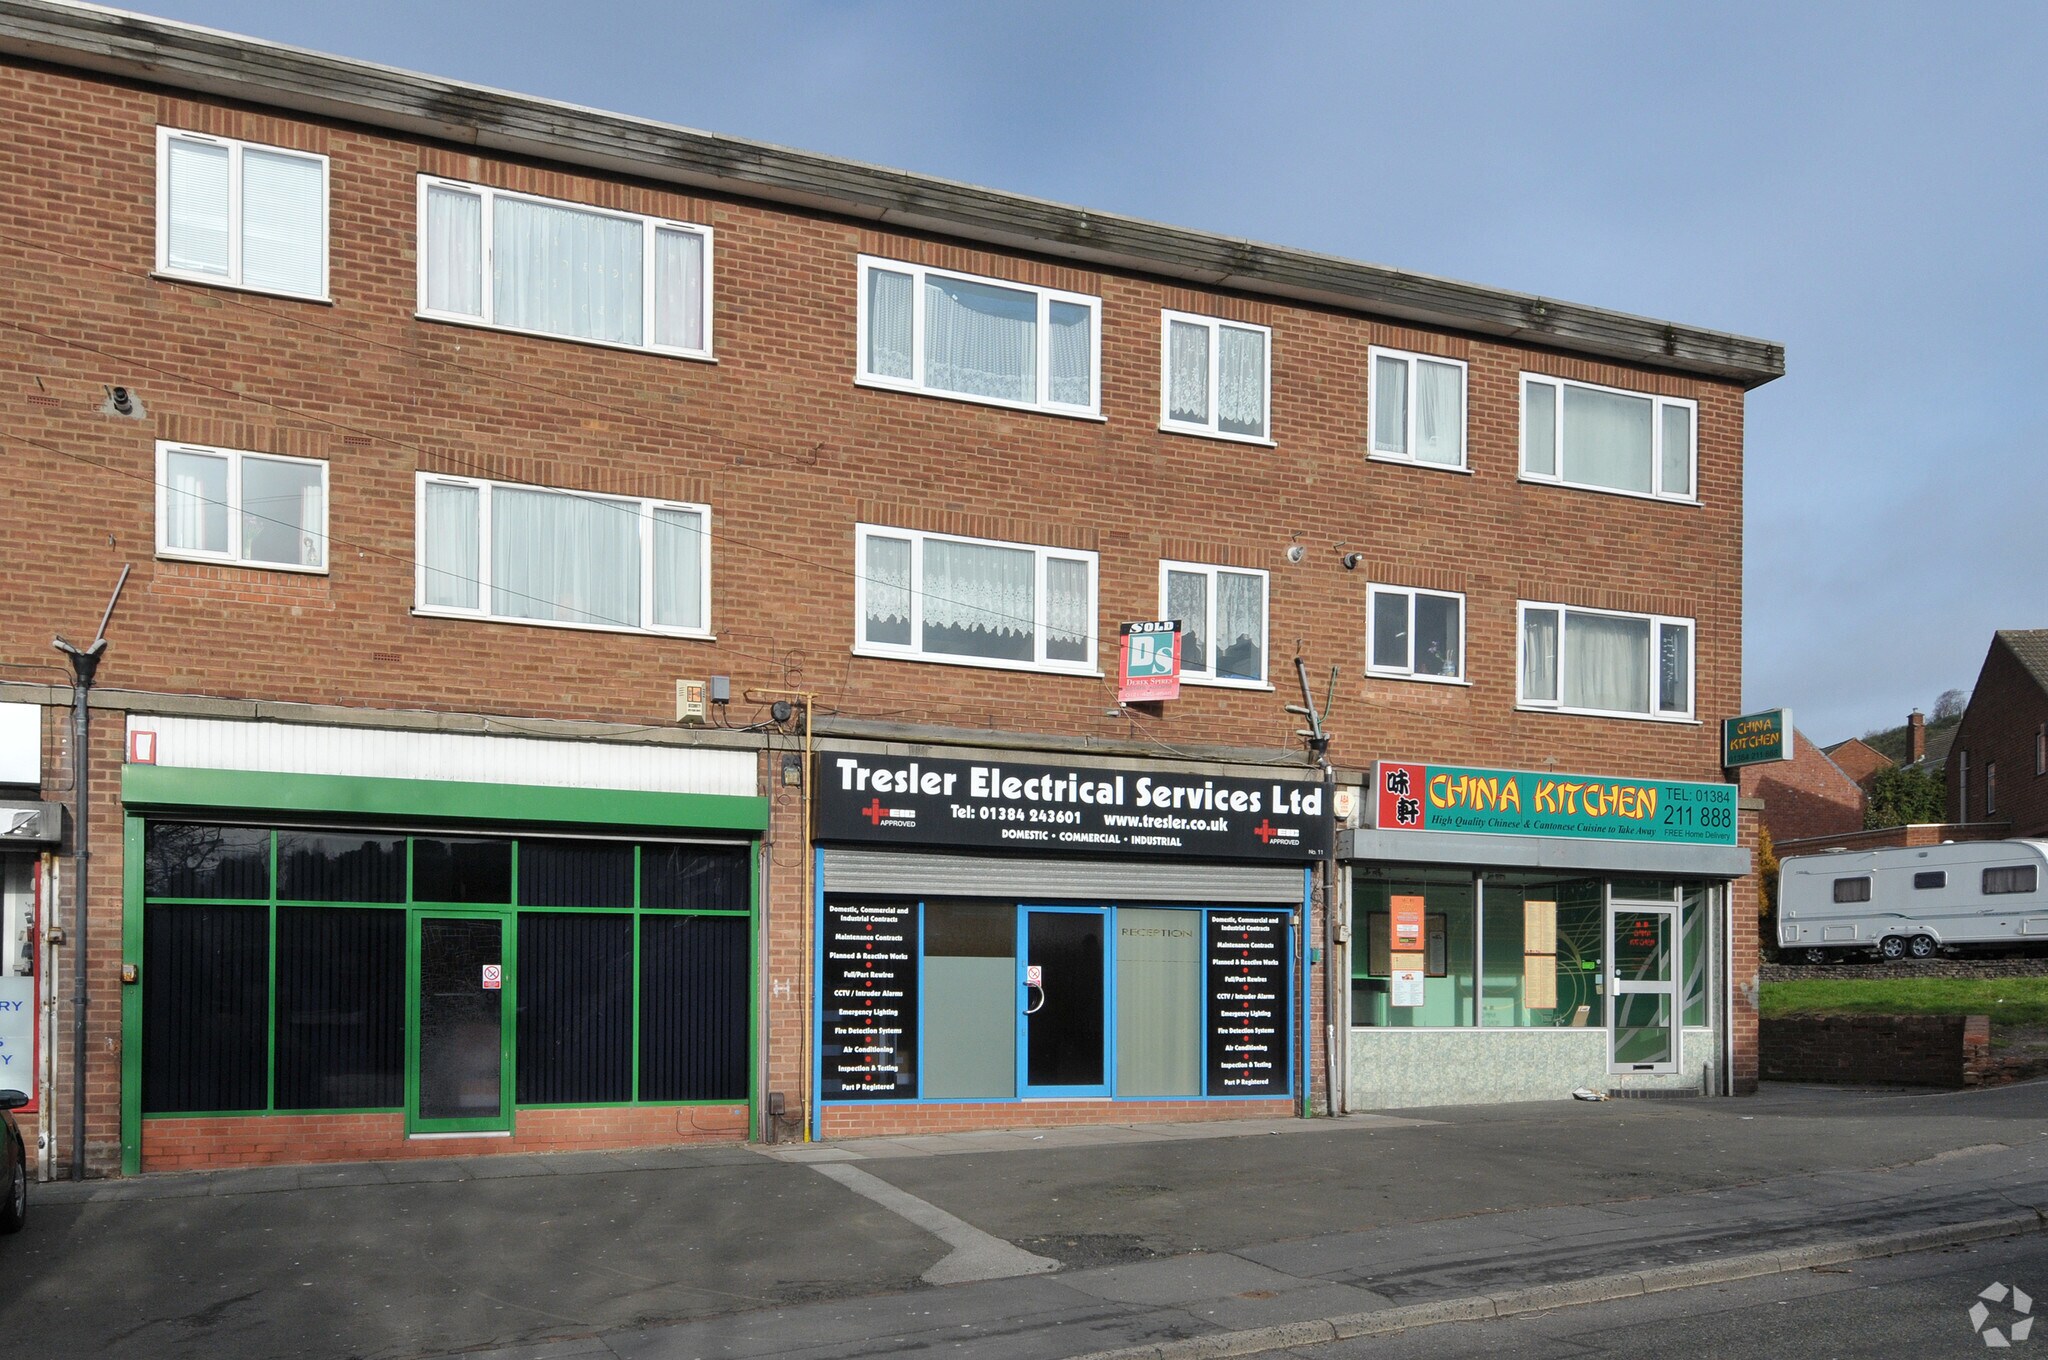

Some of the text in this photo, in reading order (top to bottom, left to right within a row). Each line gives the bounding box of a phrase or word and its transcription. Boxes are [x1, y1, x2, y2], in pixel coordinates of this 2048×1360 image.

[1129, 622, 1174, 633] SOLD
[1737, 719, 1772, 735] CHINA
[1730, 732, 1779, 751] KITCHEN
[836, 758, 1322, 816] Tresler Electrical Services Ltd
[1429, 773, 1657, 820] CHINA KITCHEN
[1666, 787, 1730, 803] TEL: 01384
[950, 804, 1081, 824] Tel: 01384 243601
[1664, 805, 1731, 828] 211 888
[880, 820, 916, 828] APPROVED
[1104, 814, 1228, 832] www.tresler.co.uk
[1431, 814, 1656, 837] High Quality Chinese & Cantonese Cuisine to Take Away
[1001, 829, 1182, 846] DOMESTIC COMMERCIAL INDUSTRIAL
[1664, 829, 1731, 840] FREE Home Delivery
[1269, 838, 1300, 846] APPROVED
[835, 933, 874, 941] Maintenance
[1121, 928, 1193, 938] RECEPTION
[839, 1008, 872, 1016] Emergency
[879, 1027, 902, 1035] Systems
[854, 1046, 894, 1054] Conditioning
[838, 1065, 870, 1073] Inspection
[862, 1083, 894, 1092] Registered
